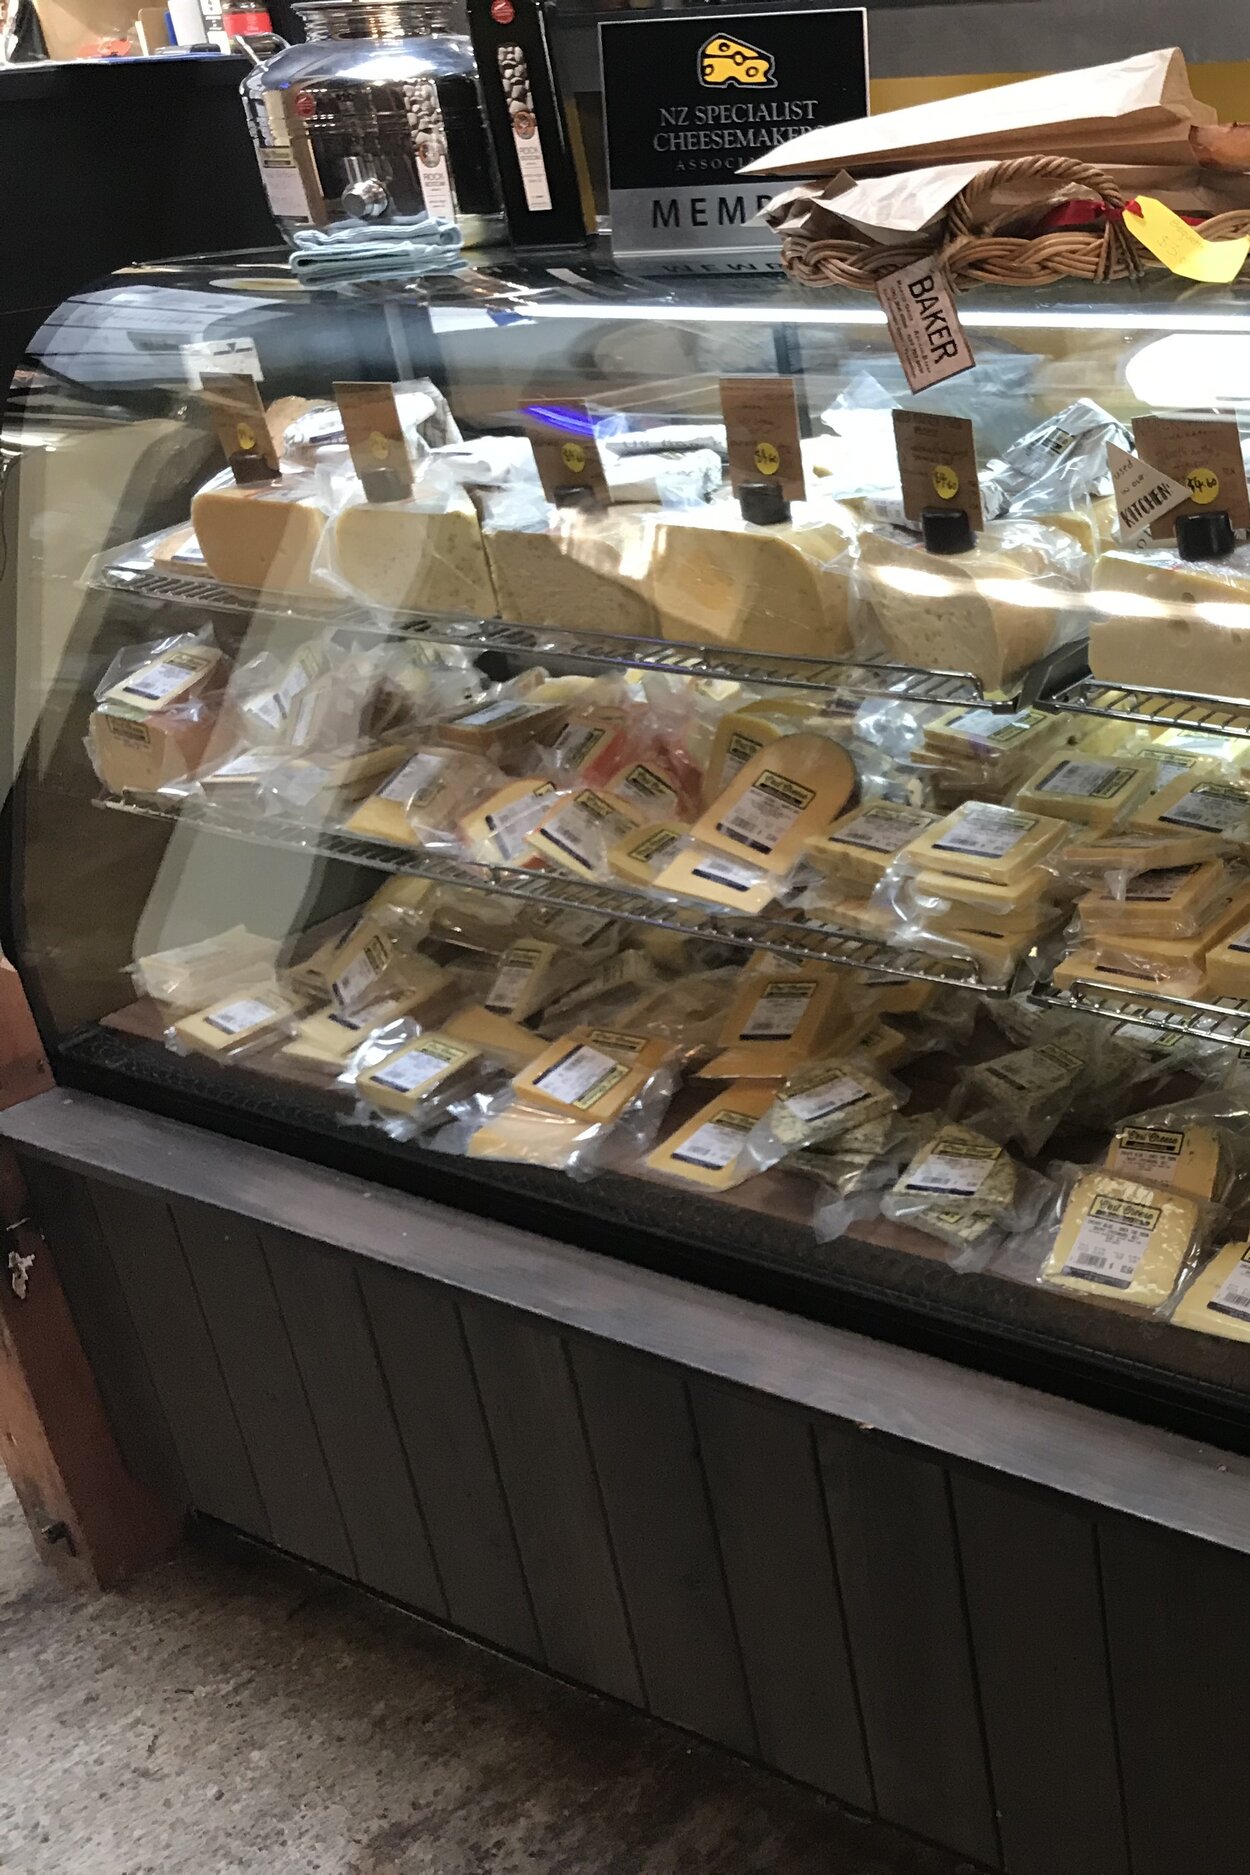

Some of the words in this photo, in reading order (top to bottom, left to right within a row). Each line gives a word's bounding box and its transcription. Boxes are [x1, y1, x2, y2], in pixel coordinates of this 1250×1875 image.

[659, 107, 690, 126] NZ
[694, 100, 818, 125] SPECIALIST
[653, 126, 824, 151] CHEESEMAKE
[908, 275, 958, 365] BAKER
